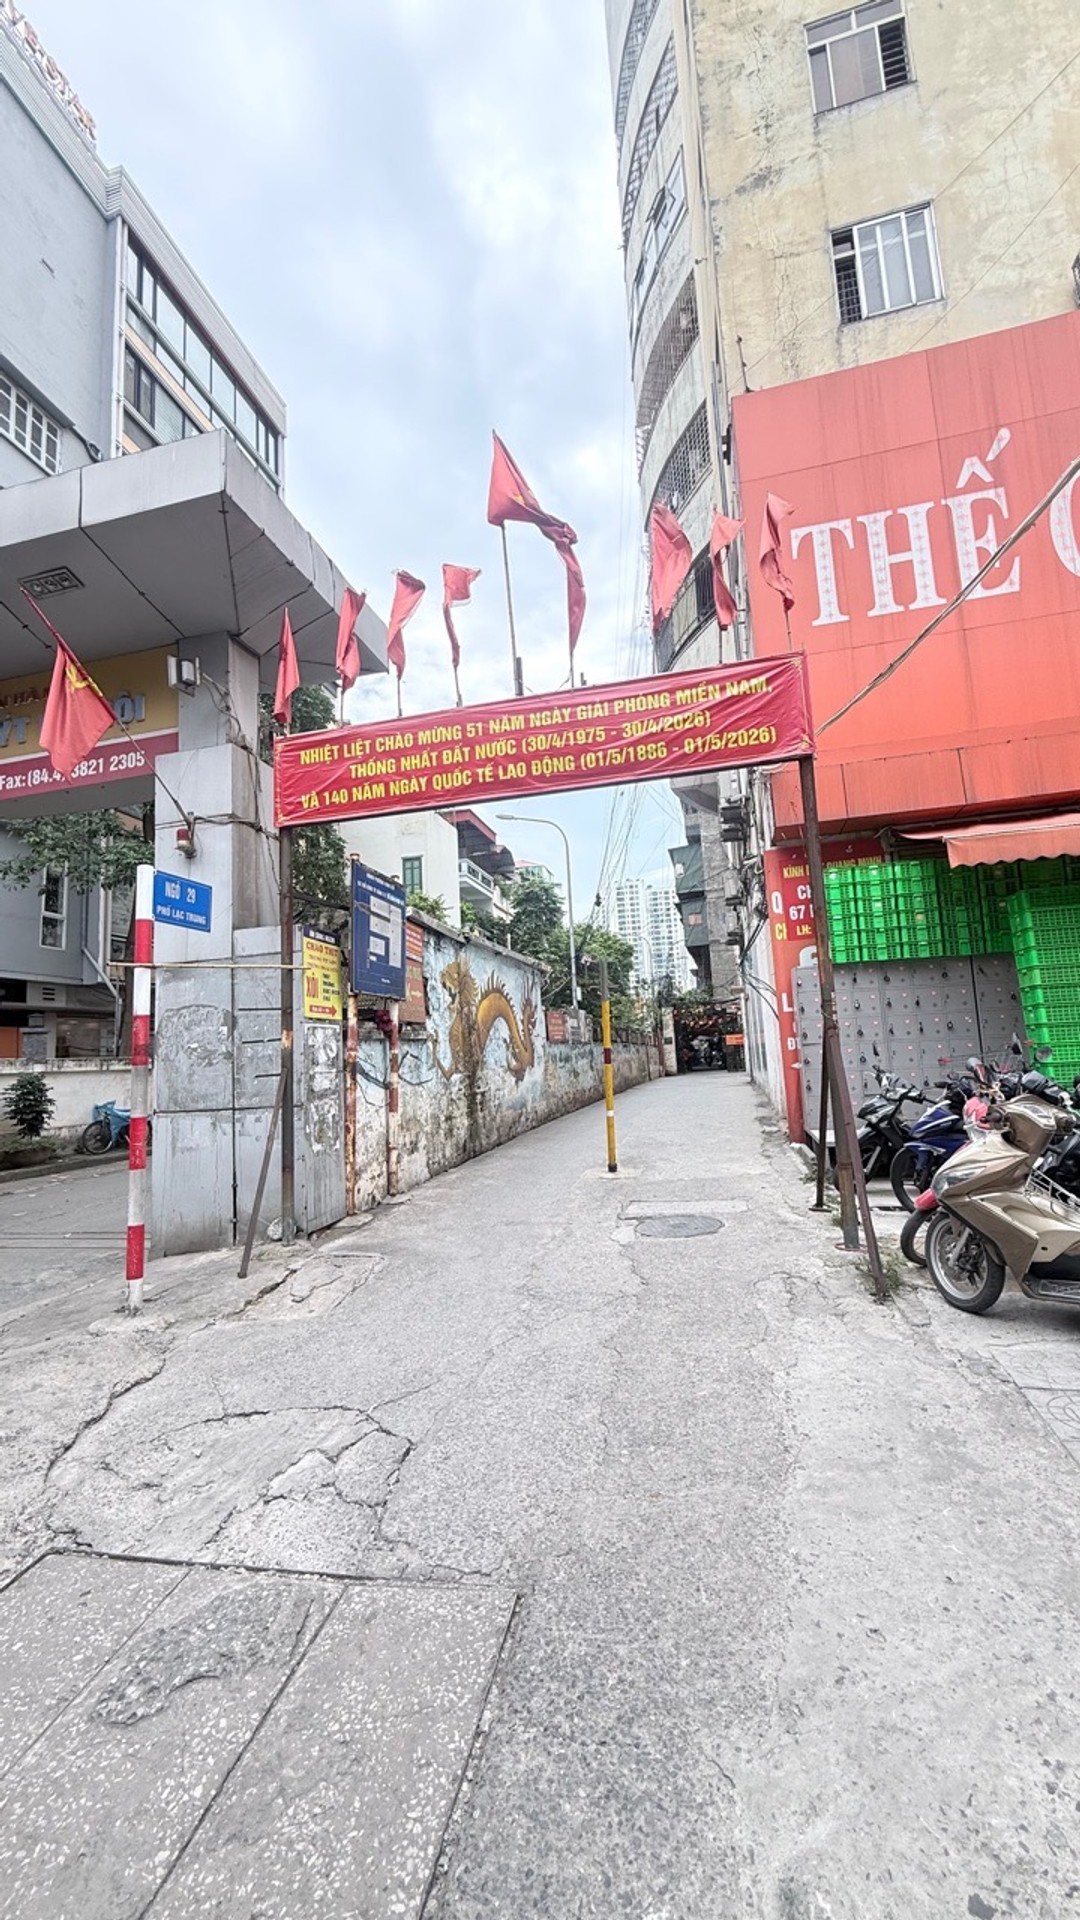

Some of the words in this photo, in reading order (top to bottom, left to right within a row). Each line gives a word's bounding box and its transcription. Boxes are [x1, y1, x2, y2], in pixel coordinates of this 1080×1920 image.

[790, 427, 1021, 627] THẾ
[300, 744, 339, 765] NHIỆT
[343, 738, 371, 759] LIỆT
[375, 732, 413, 753] CHÀO
[418, 725, 462, 746] MỪNG
[466, 722, 483, 738] 51
[489, 713, 525, 735] NĂM
[529, 706, 571, 728] NGÀY
[576, 698, 608, 720] GIẢI
[613, 689, 670, 715] PHÓNG
[675, 680, 720, 706] MIỀN
[725, 676, 773, 697] NAM,
[349, 755, 396, 779] THỐNG
[400, 747, 438, 771] NHẤT
[442, 743, 471, 764] ĐẤT
[475, 737, 517, 761] NƯỚC
[522, 726, 606, 754] (30/4/1975
[622, 710, 711, 738] 30/4/2026)
[71, 757, 104, 779] 3821
[110, 750, 145, 772] 2305
[301, 790, 320, 809] VÀ
[323, 788, 349, 806] 140
[352, 781, 385, 802] NĂM
[390, 775, 429, 797] NGÀY
[432, 766, 472, 792] QUỐC
[476, 762, 495, 784] TẾ
[498, 761, 527, 780] LAO
[531, 754, 575, 779] ĐỘNG
[580, 741, 668, 771] (01/5/1886
[683, 725, 777, 755] 01/5/2026)
[782, 864, 804, 879] KÍNH
[186, 886, 196, 904] 29
[156, 904, 171, 917] PHỐ
[172, 908, 185, 920] LẠC
[186, 911, 206, 925] TRUNG
[788, 904, 805, 921] 67
